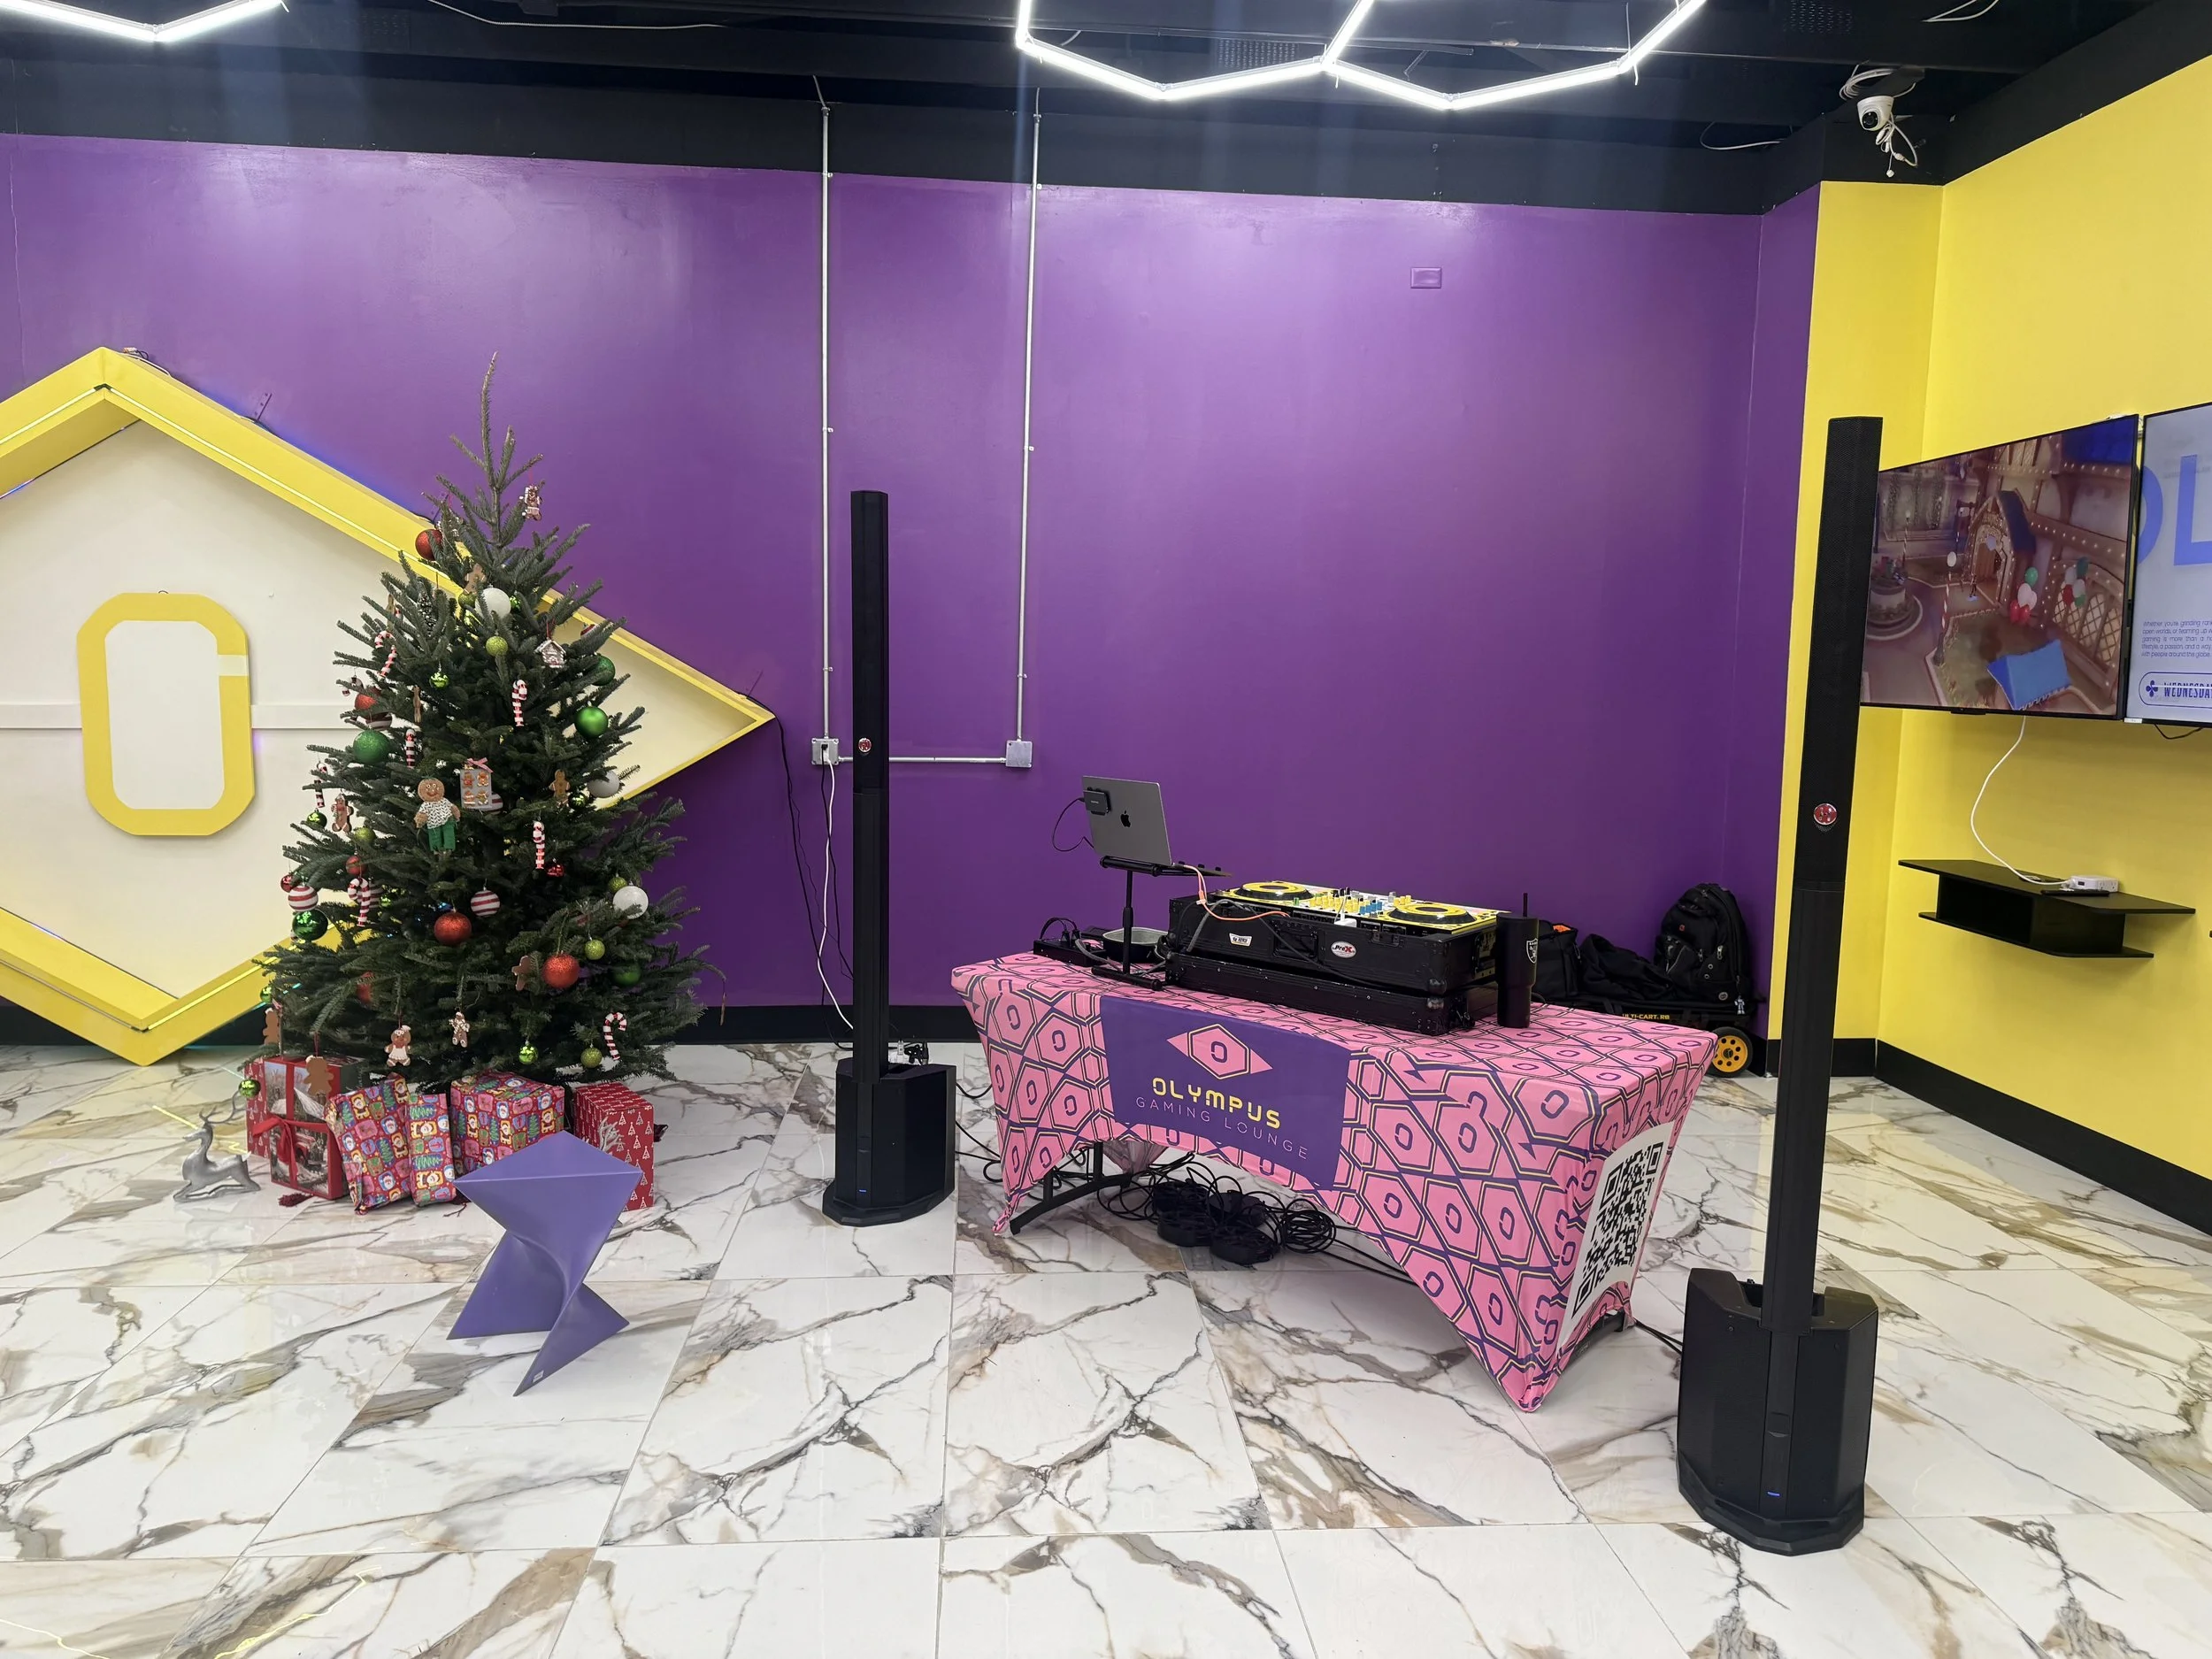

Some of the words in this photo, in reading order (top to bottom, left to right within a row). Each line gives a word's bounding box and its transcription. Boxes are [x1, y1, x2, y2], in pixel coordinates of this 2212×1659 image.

[2163, 682, 2212, 698] WEDNESDA
[1135, 1096, 1211, 1123] GAMING
[1224, 1117, 1309, 1160] LOUNGE
[1152, 1077, 1281, 1130] OLYMPUS
